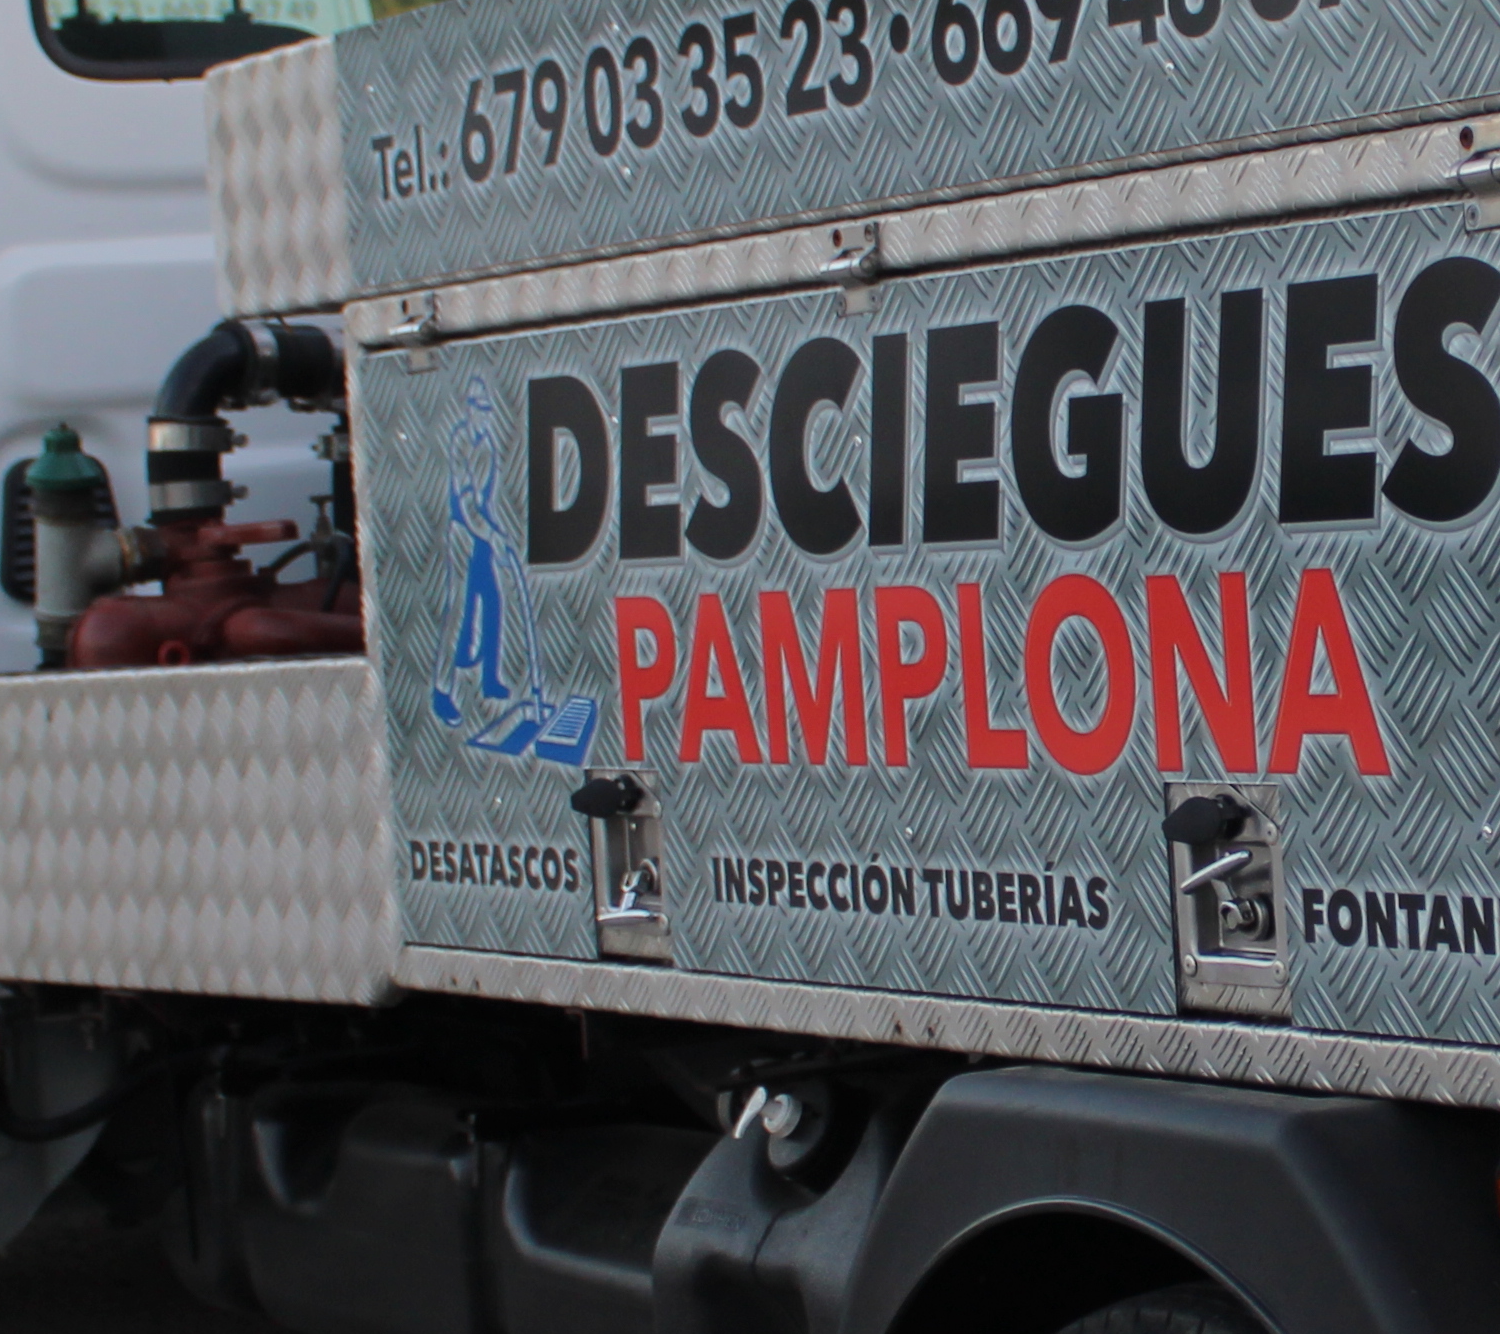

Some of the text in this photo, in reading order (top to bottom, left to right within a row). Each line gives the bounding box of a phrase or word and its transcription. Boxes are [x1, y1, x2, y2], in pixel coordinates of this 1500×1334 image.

[371, 125, 449, 201] Tel.:
[460, 60, 568, 184] 679
[584, 37, 664, 156] 03
[678, 11, 764, 137] 35
[612, 567, 1390, 777] PAMPLONA
[409, 840, 580, 894] DESATASCOS
[712, 852, 1111, 933] INSPECCIÓN TUBERÍAS
